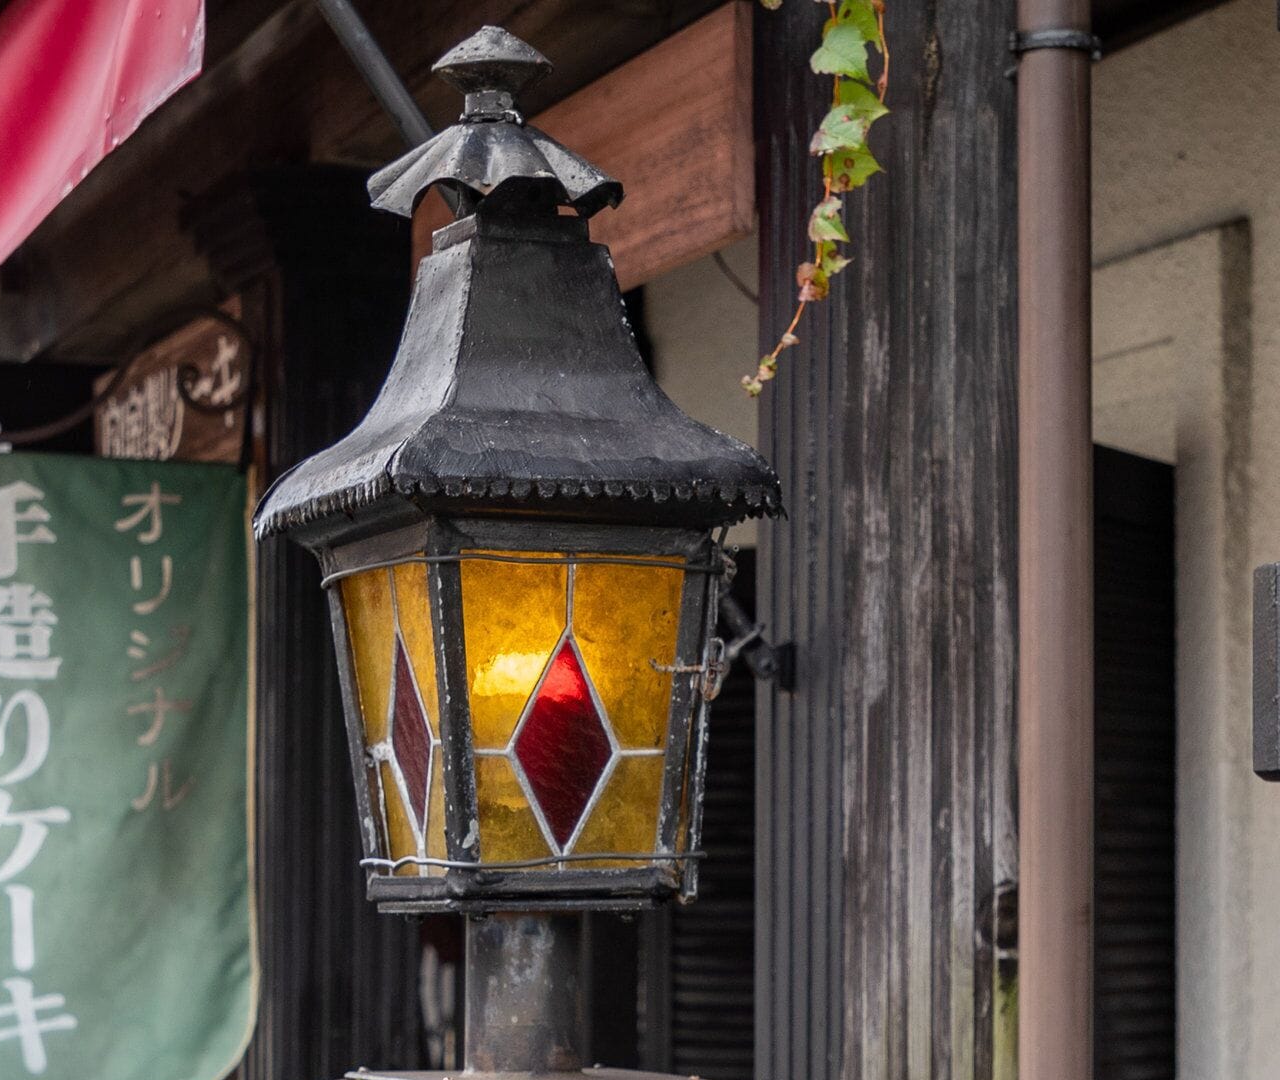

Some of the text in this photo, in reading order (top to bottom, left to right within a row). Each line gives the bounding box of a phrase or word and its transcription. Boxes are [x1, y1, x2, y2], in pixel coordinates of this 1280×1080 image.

[113, 483, 195, 812] オリジナル
